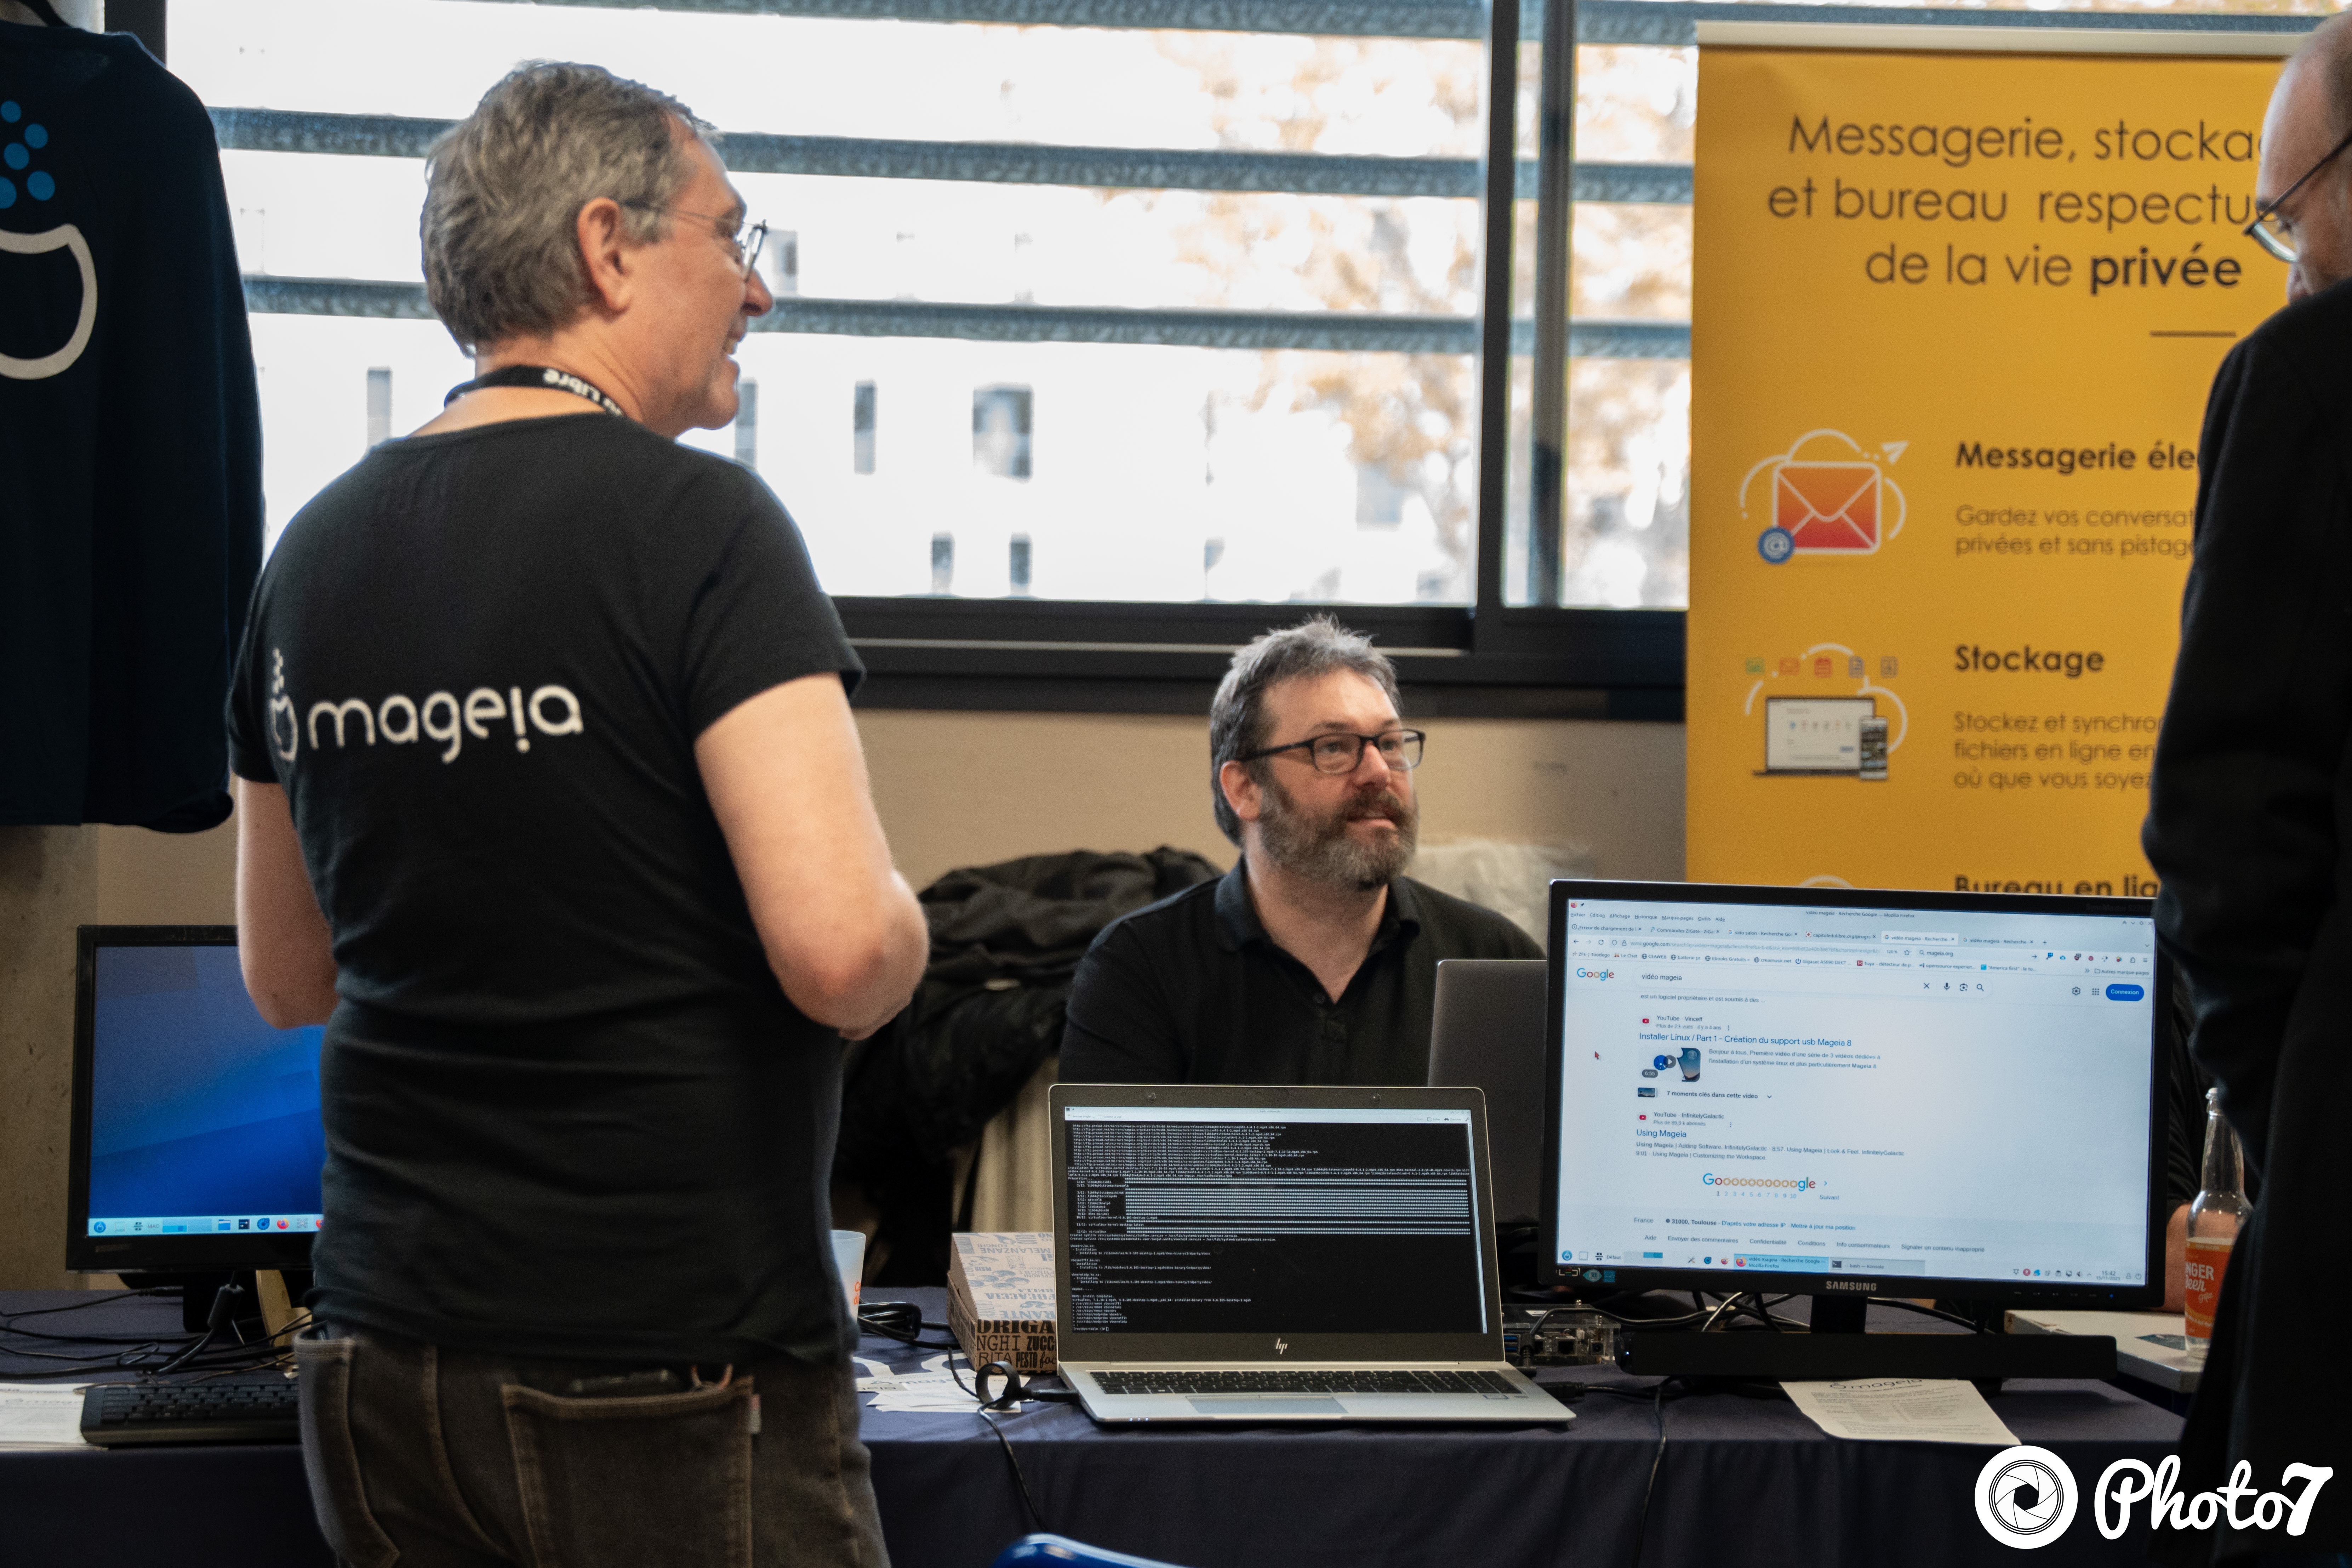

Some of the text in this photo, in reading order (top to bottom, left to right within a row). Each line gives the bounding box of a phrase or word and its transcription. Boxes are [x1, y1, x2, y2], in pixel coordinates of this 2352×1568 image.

[1788, 114, 2261, 168] Messagerie, stocka
[1769, 178, 1817, 218] et
[1835, 178, 2007, 221] bureau
[1865, 243, 2242, 295] de la vie privée
[1956, 441, 2136, 475] Messagerie
[1956, 505, 2037, 527] Gardez
[2044, 508, 2079, 528] vos
[1956, 533, 2032, 557] privées
[2039, 535, 2060, 554] et
[2067, 537, 2114, 556] sans
[1955, 644, 2105, 679] Stockage
[307, 684, 584, 763] mageia
[1953, 712, 2038, 731] Stockez
[2045, 713, 2067, 731] et
[1954, 740, 2028, 760] fichiers
[2036, 744, 2061, 760] en
[2069, 740, 2122, 766] ligne
[1954, 768, 1981, 788] où
[1989, 771, 2031, 791] que
[2039, 772, 2087, 788] vous
[1955, 874, 2062, 895] Bureau
[2073, 880, 2118, 896] en
[1577, 968, 1614, 981] Google
[1725, 1034, 1757, 1043] Création
[1818, 1038, 1845, 1047] Mageia
[1637, 1129, 1686, 1138] Using Mageia
[1826, 1281, 1877, 1291] SAMSUNG
[977, 1335, 1056, 1351] NGHI ZUCC
[1016, 1352, 1038, 1368] PESTO
